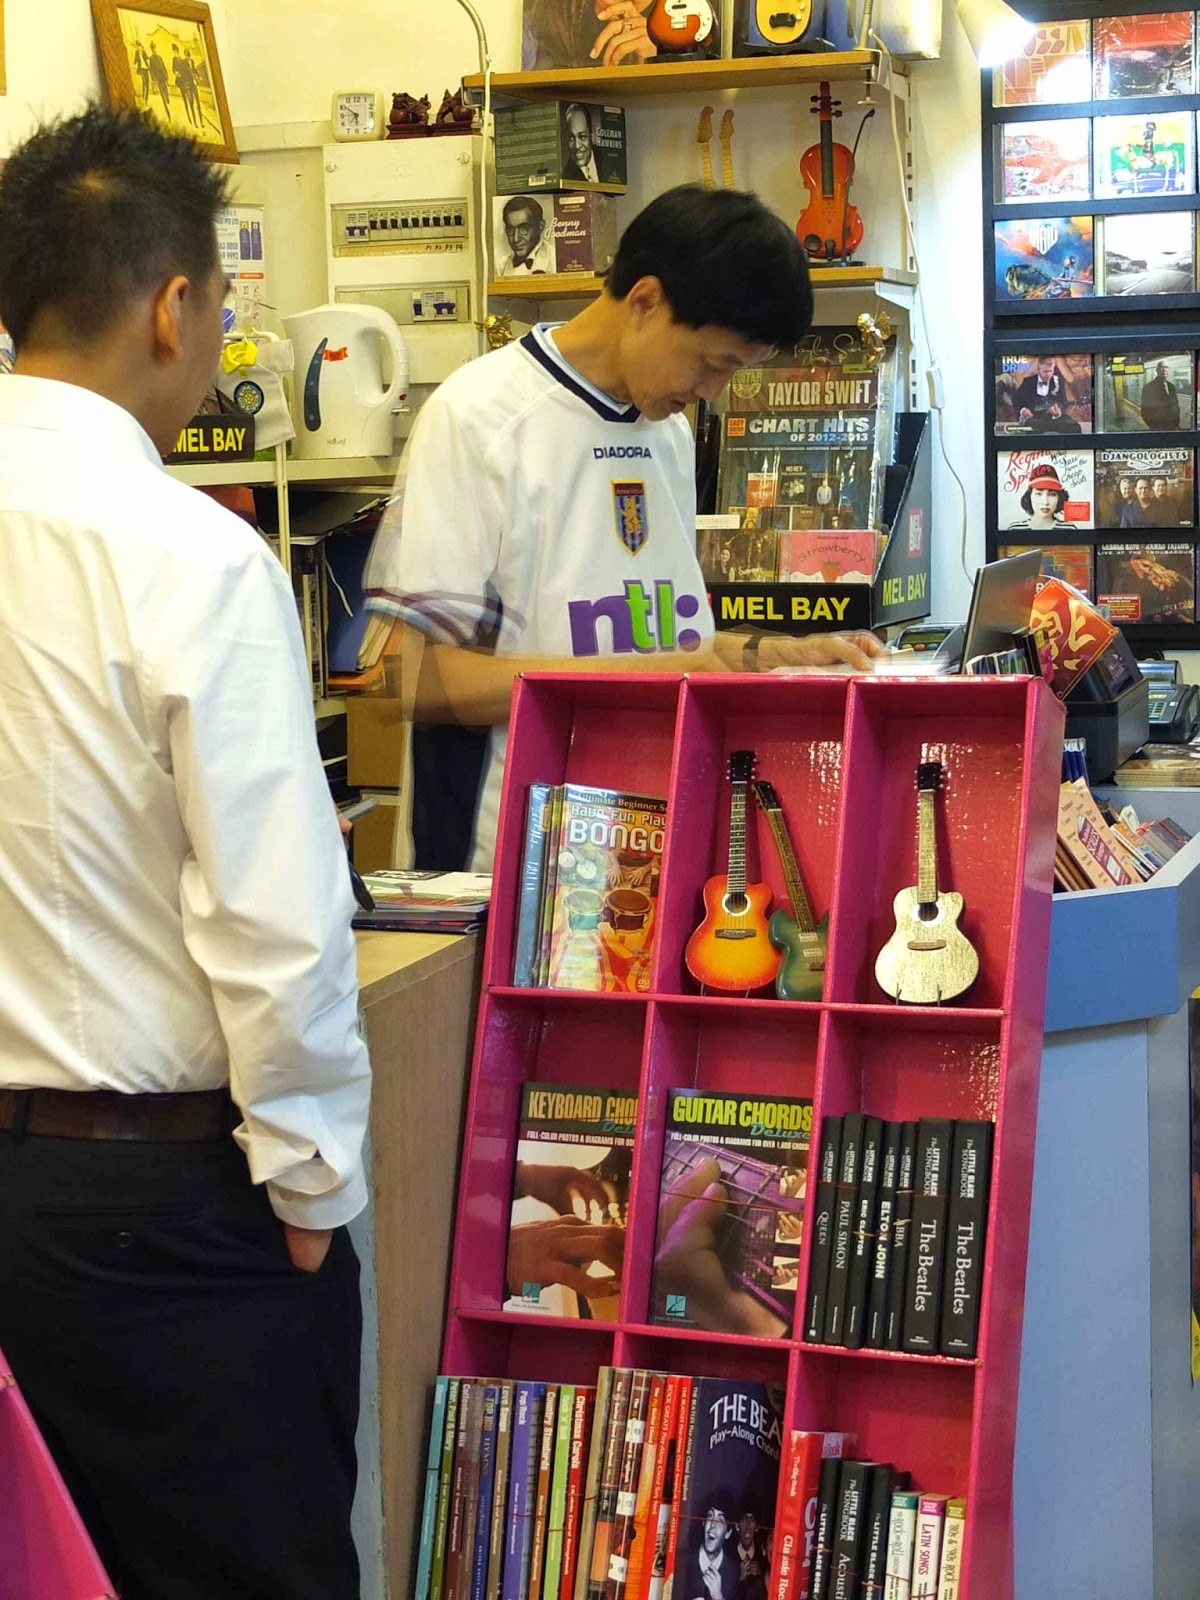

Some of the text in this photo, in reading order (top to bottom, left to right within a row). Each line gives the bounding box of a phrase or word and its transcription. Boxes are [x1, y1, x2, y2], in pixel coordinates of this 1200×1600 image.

[596, 127, 622, 138] COLEMAN
[596, 138, 623, 149] HAWKINS
[544, 227, 587, 240] Goodman
[551, 217, 580, 230] Benny
[768, 380, 872, 406] TAYLOR SWIFT
[749, 418, 870, 434] CHART HITS
[790, 432, 868, 442] OF 2012-2013
[212, 427, 246, 452] BAY
[593, 446, 652, 460] DIADORA
[1102, 451, 1188, 462] DJANGOLOGISTS
[798, 543, 866, 563] Strawberry
[882, 572, 927, 607] MEL BAY
[721, 596, 850, 620] MEL BAY
[571, 804, 635, 824] Have Fun
[618, 798, 658, 810] Beginner
[528, 1090, 602, 1123] KEYBOARD
[672, 1096, 814, 1132] GUITAR CHORDS
[558, 1133, 580, 1142] PHOTOS
[586, 1135, 614, 1146] DIAGRAMS
[700, 1134, 719, 1144] PHOTOS
[725, 1136, 752, 1146] DIAGRAMS
[752, 1138, 762, 1147] FOR
[762, 1139, 776, 1148] OVER
[750, 1123, 811, 1140] Deluxe
[922, 1147, 935, 1196] SONGBOOK
[931, 1147, 940, 1171] LITTLE
[968, 1150, 977, 1174] LITTLE
[930, 1173, 938, 1196] BLACK
[958, 1148, 971, 1198] SONGBOOK
[966, 1175, 976, 1198] BLACK
[860, 1199, 868, 1218] ERIC
[815, 1211, 829, 1245] QUEEN
[835, 1201, 850, 1269] PAUL SIMON
[874, 1201, 890, 1279] ELTON JOHN
[914, 1218, 937, 1312] The Beatles
[952, 1221, 974, 1315] The Beatles
[501, 1385, 511, 1405] Love
[665, 1384, 673, 1403] ROCK
[680, 1386, 688, 1402] THE
[691, 1386, 699, 1403] THE
[458, 1383, 472, 1430] Coffeehouse
[662, 1405, 671, 1431] GREATS
[540, 1392, 557, 1471] Country Standards
[570, 1395, 586, 1469] Christmas Carols
[709, 1393, 784, 1446] THE BEA
[710, 1424, 755, 1450] Play-Along
[655, 1466, 664, 1485] Chord
[839, 1489, 851, 1541] SONGBOOK
[849, 1491, 859, 1516] LITTLE
[847, 1517, 856, 1542] BLACK
[920, 1523, 935, 1548] LATIN
[780, 1535, 793, 1576] Classic
[813, 1513, 827, 1594] LITTLE BLACK BOOK
[868, 1522, 880, 1579] LITTLE BLACK
[918, 1550, 930, 1575] SONGS
